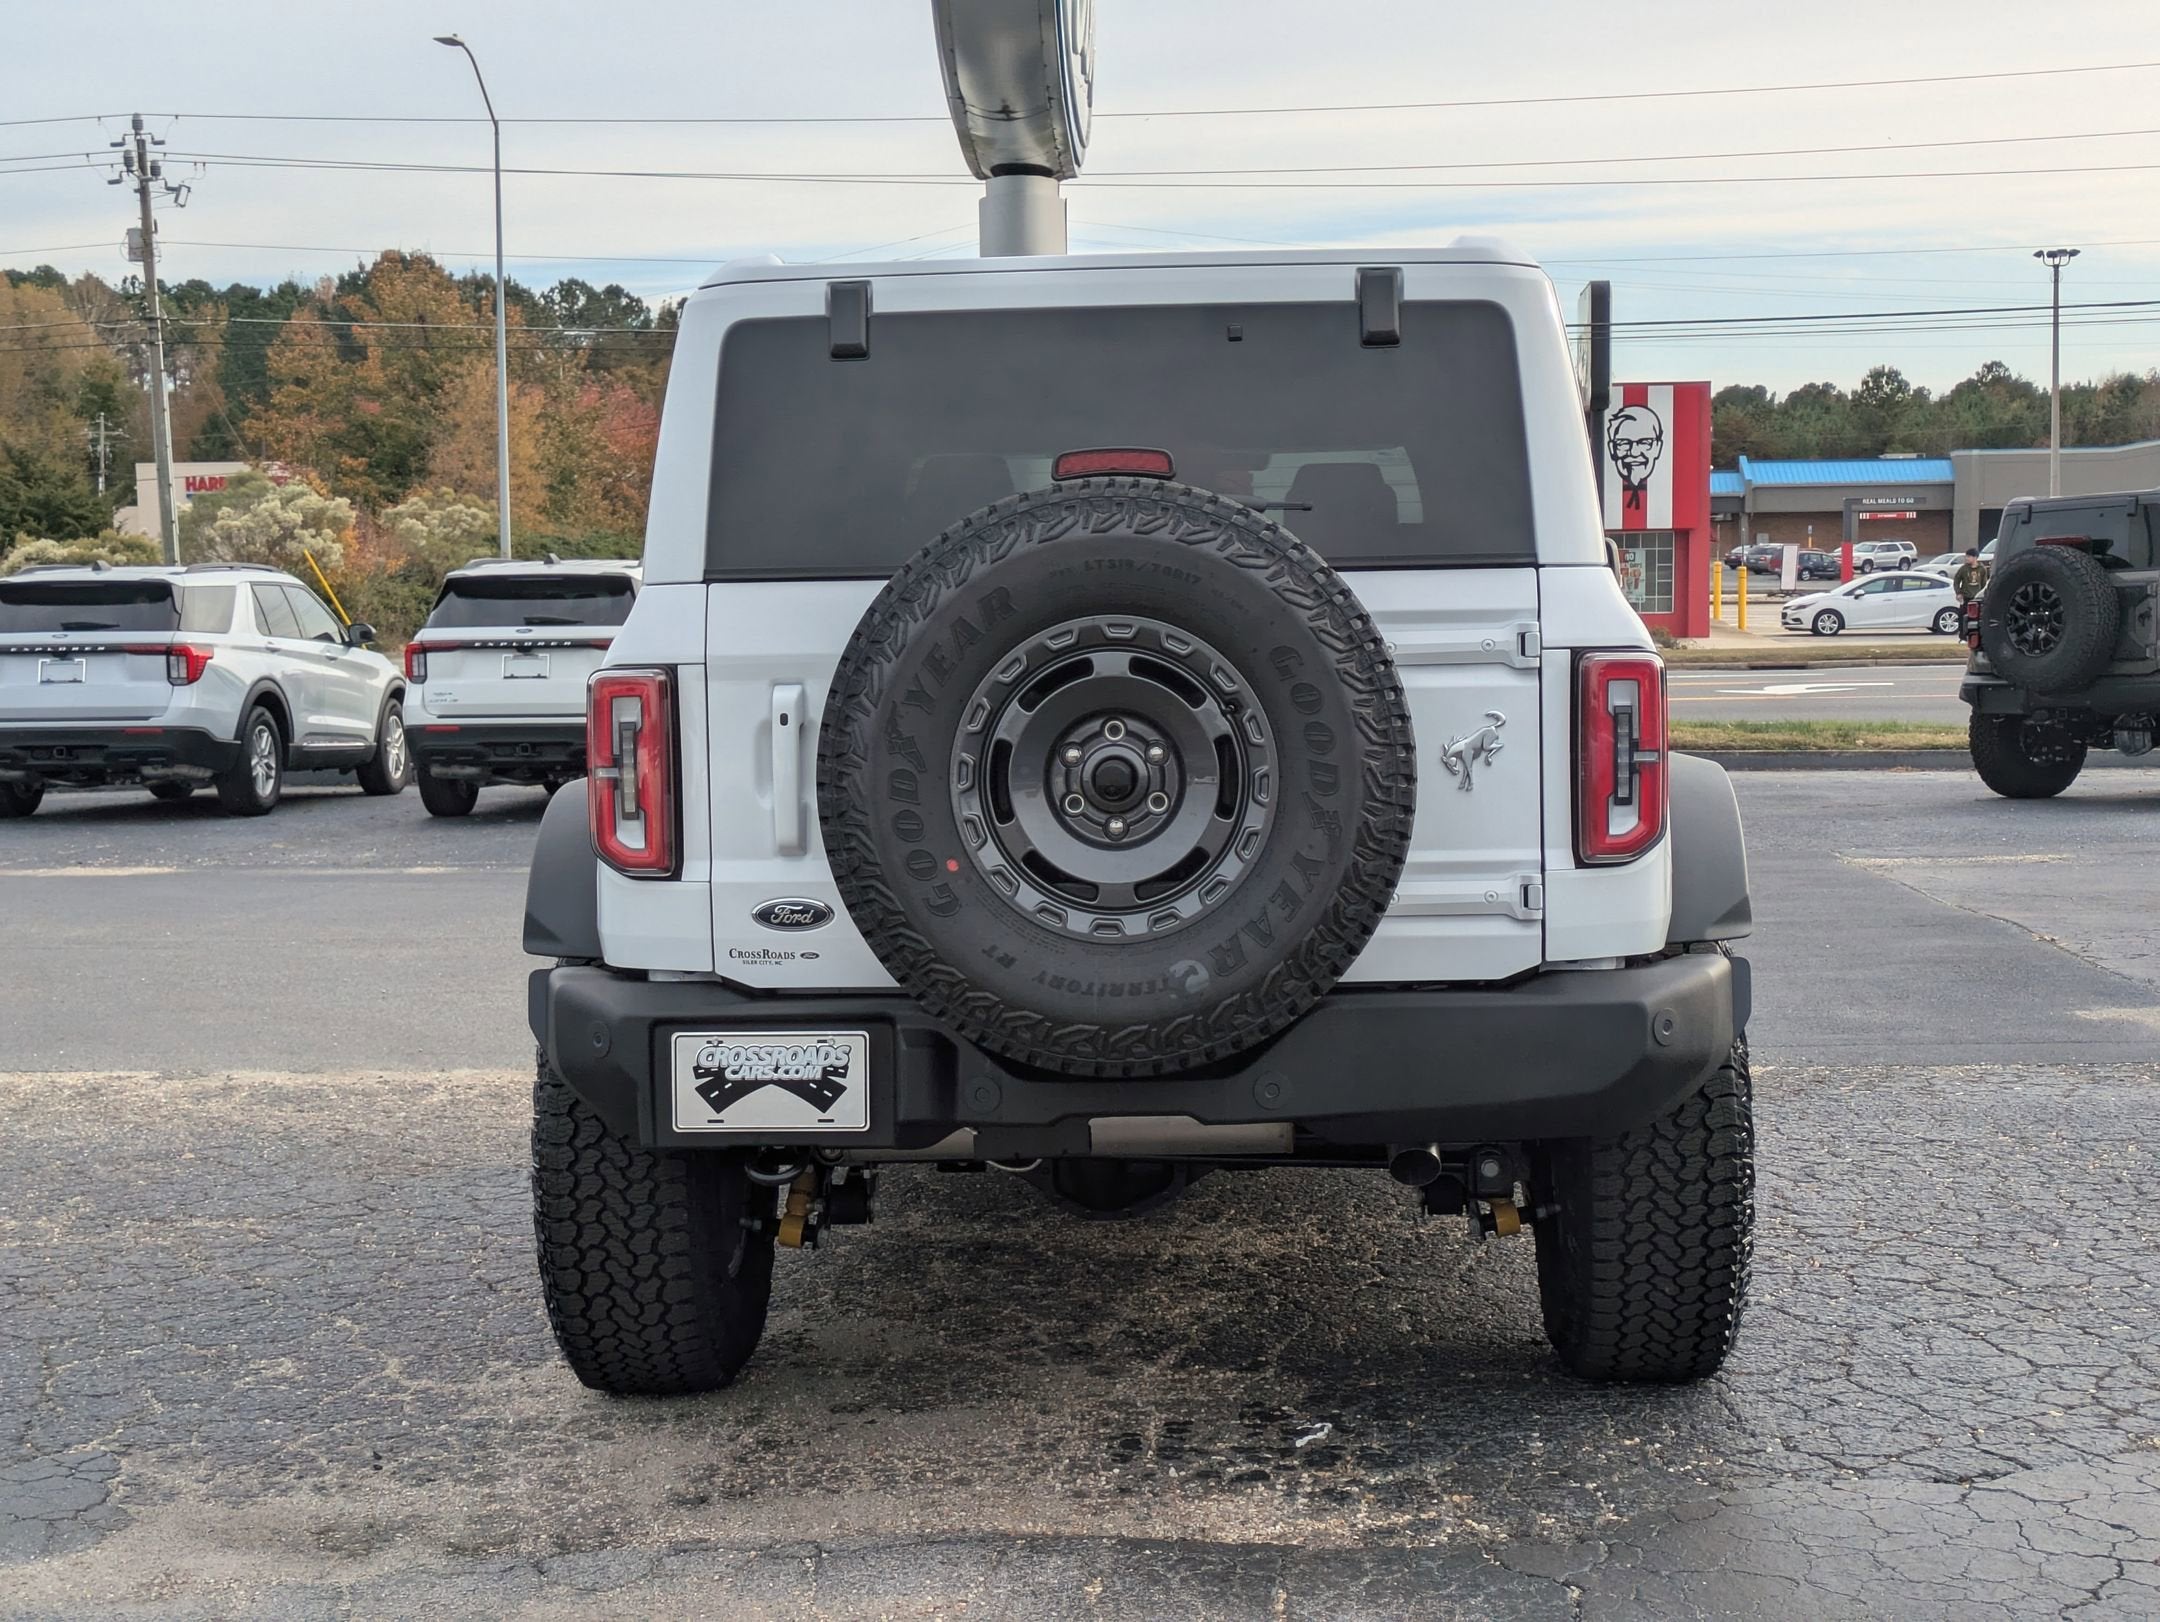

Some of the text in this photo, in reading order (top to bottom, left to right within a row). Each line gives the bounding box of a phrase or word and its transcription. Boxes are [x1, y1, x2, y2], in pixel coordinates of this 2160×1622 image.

[770, 904, 815, 924] Ford
[1031, 969, 1169, 998] TERRITORY
[697, 1045, 852, 1068] CROSSROADS
[724, 1065, 823, 1081] CARS.COM
